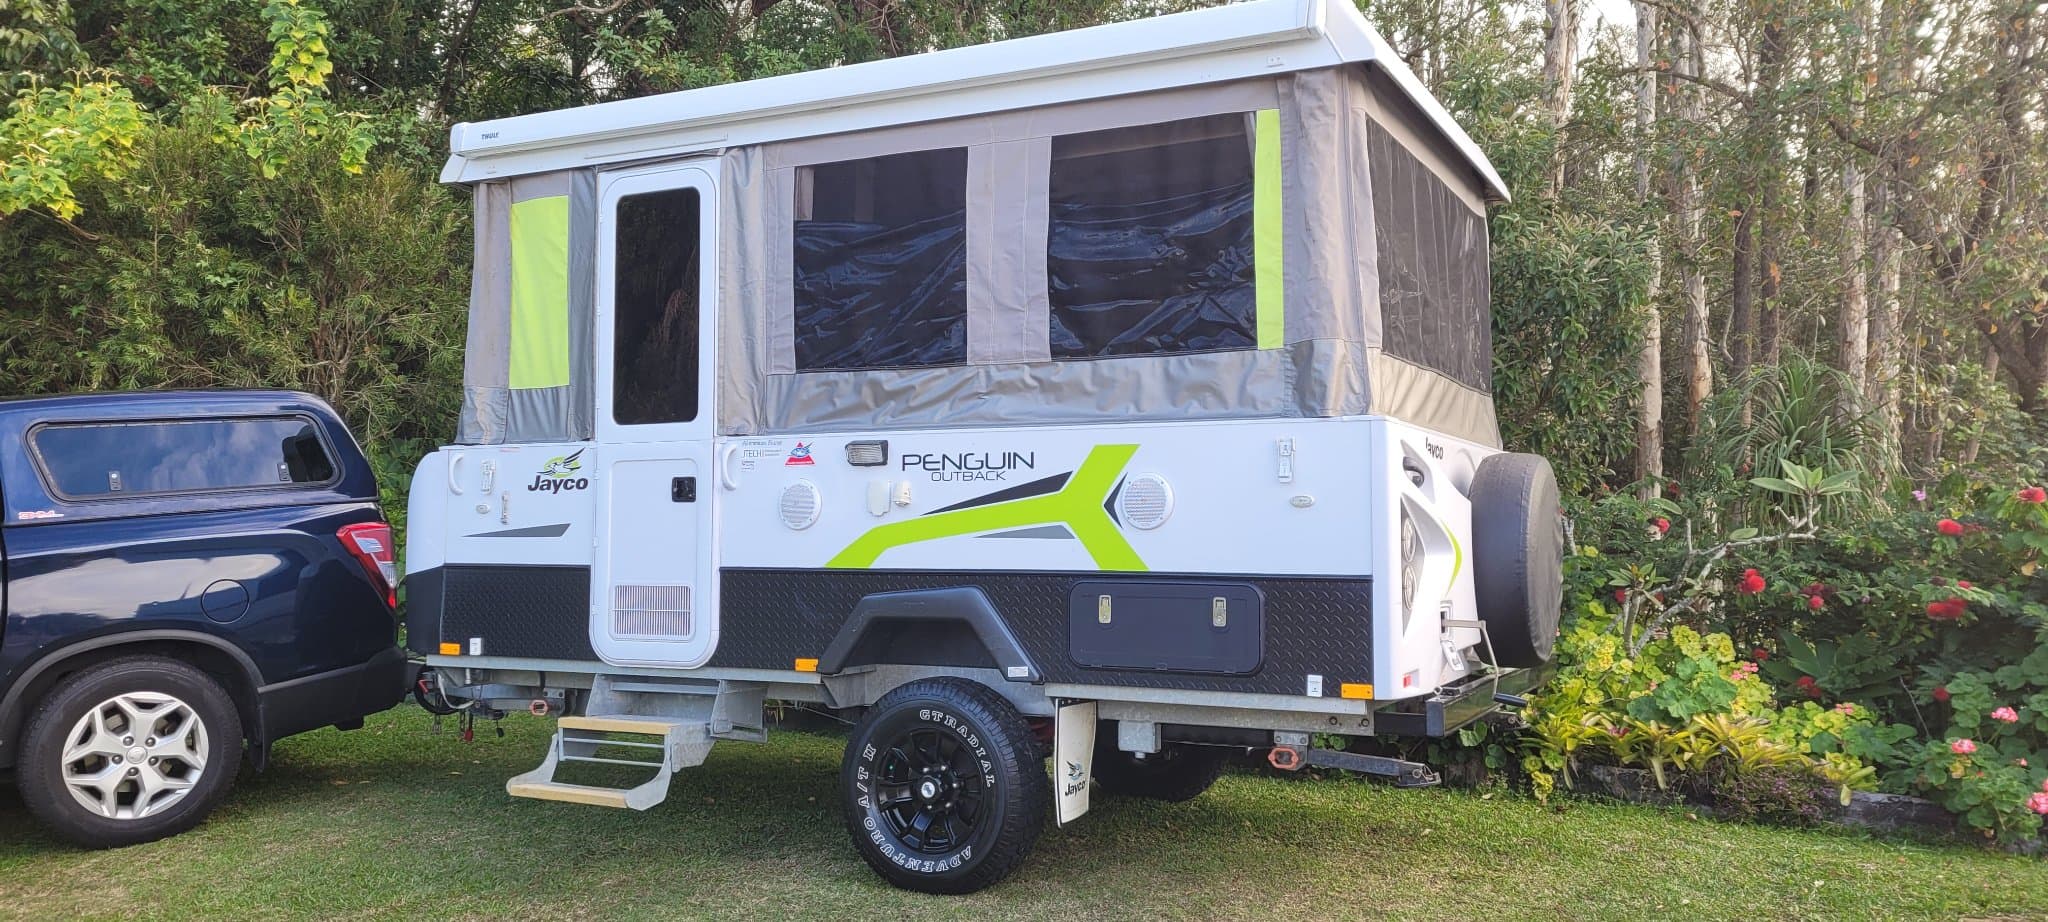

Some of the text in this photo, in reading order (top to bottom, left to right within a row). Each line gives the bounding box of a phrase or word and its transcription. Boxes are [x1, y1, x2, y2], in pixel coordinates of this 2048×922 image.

[901, 451, 1035, 471] PENGUIN
[527, 475, 589, 495] Jayco
[931, 470, 1007, 482] OUTBACK
[856, 766, 870, 809] A/T
[1064, 780, 1086, 797] Jayco
[863, 816, 972, 873] ADVENTURO
